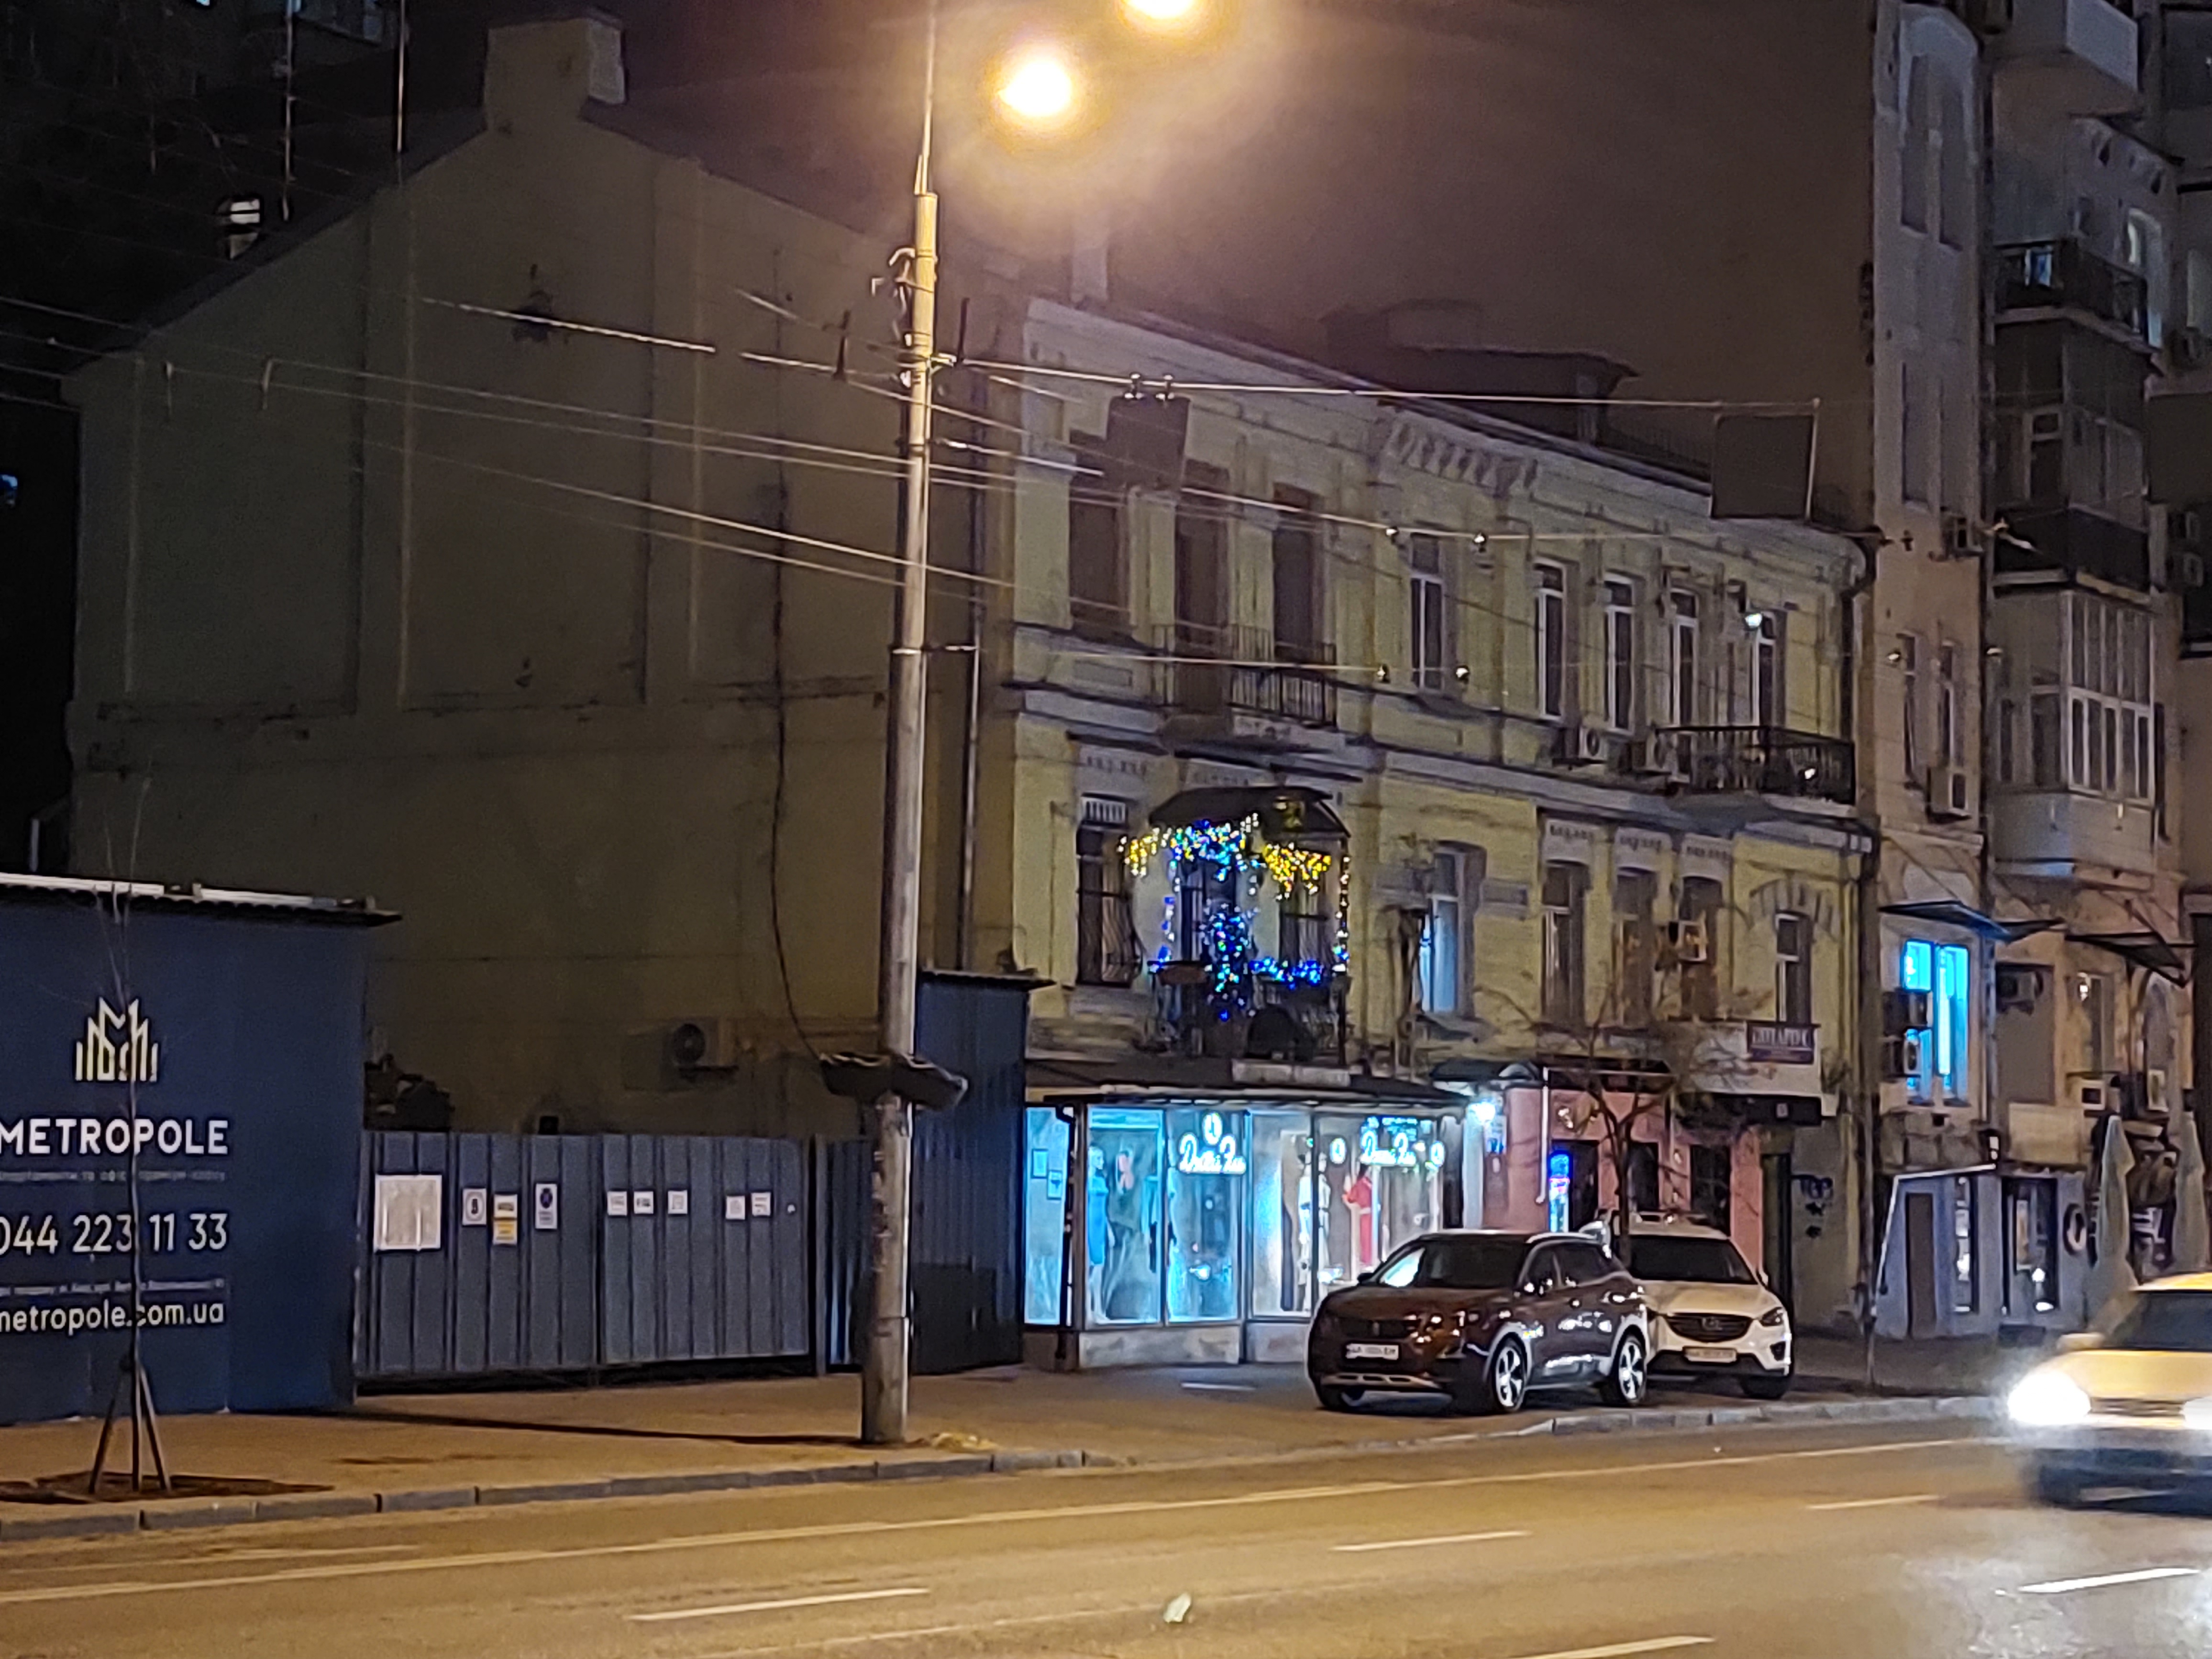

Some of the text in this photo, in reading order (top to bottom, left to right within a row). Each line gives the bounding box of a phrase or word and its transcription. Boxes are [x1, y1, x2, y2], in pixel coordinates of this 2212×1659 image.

[0, 1118, 228, 1155] METROPOLE
[72, 1214, 132, 1252] 223
[149, 1213, 175, 1252] 11
[188, 1213, 228, 1250] 33
